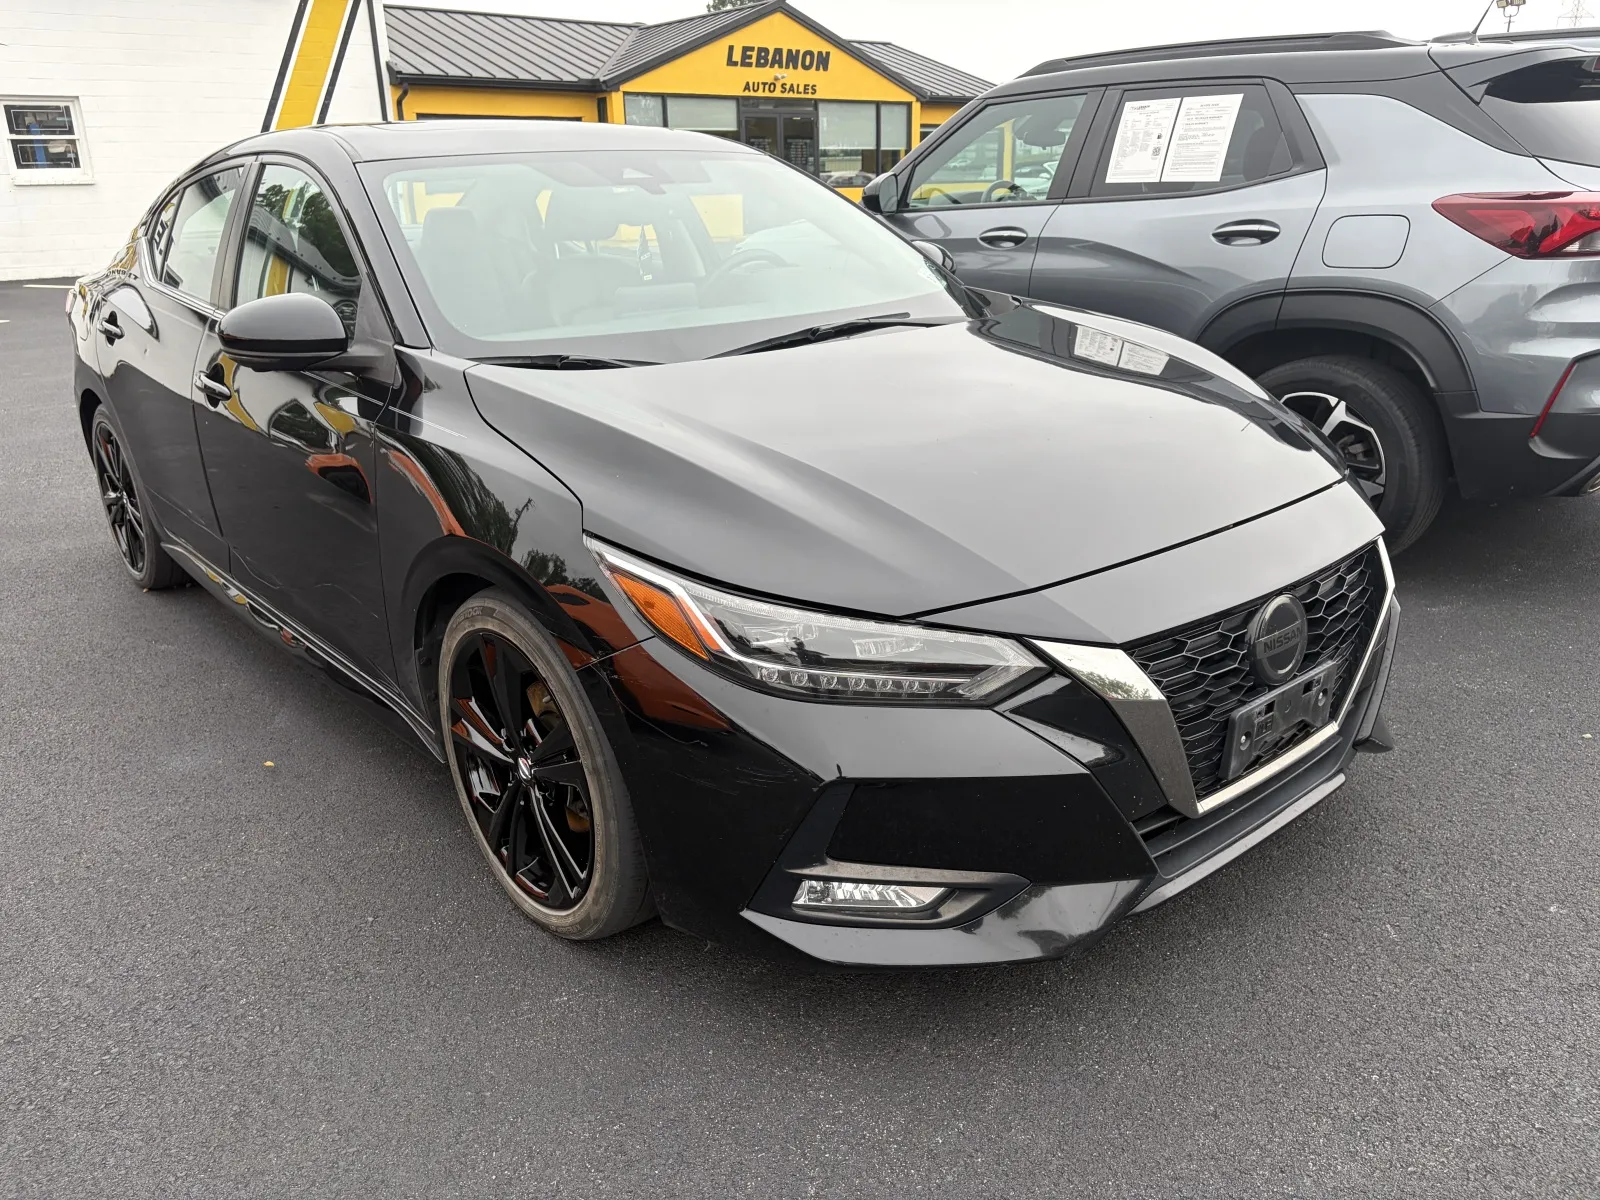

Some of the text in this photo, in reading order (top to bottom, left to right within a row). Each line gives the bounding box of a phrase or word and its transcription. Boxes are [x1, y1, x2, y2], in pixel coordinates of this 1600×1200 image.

[726, 45, 830, 71] LEBANON
[743, 81, 817, 95] AUTO SALES
[1263, 625, 1303, 653] NISSAN
